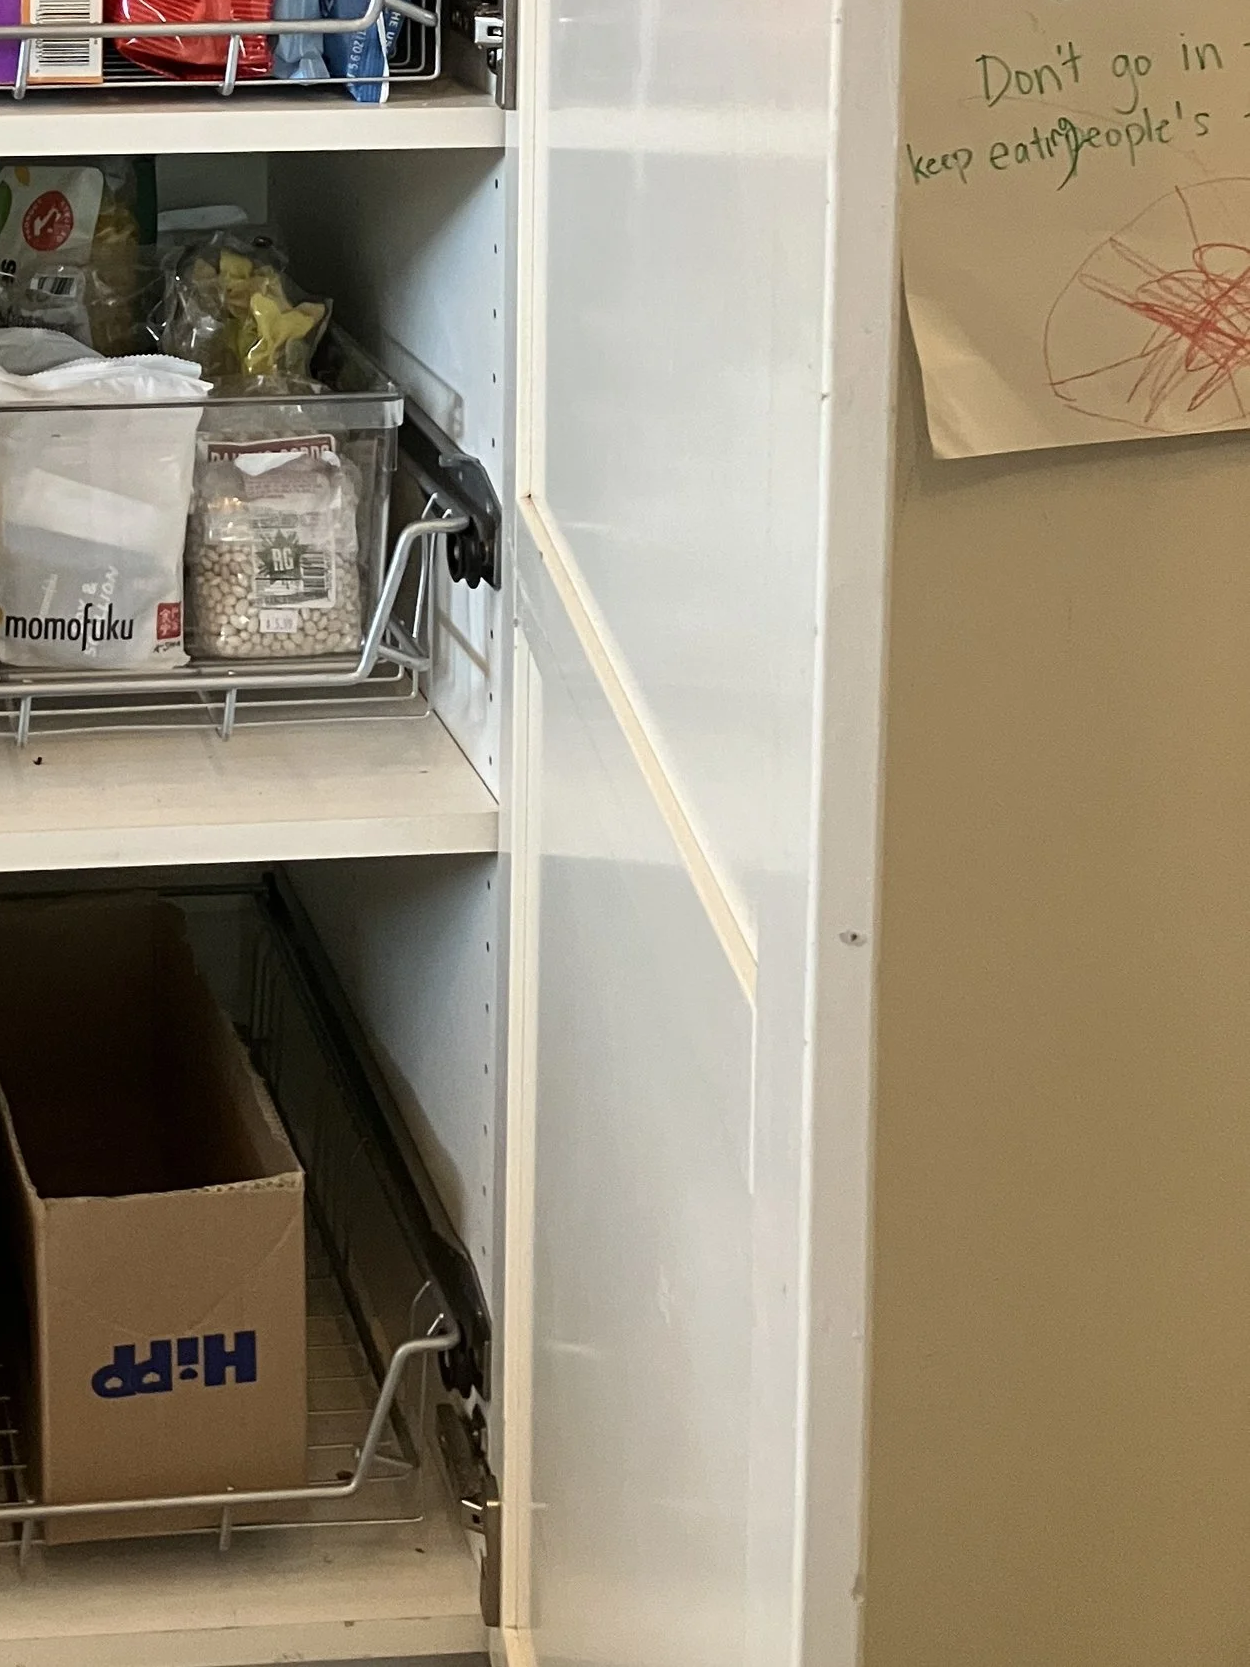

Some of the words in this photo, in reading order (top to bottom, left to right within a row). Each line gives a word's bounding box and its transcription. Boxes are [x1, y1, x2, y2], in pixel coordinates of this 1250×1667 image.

[975, 41, 1082, 107] Don't
[1112, 54, 1151, 115] go
[1179, 32, 1223, 71] in
[906, 143, 973, 185] keep
[990, 117, 1078, 191] eating
[1065, 100, 1210, 177] people's
[5, 602, 134, 651] momofuku
[91, 1330, 257, 1398] HiPP
